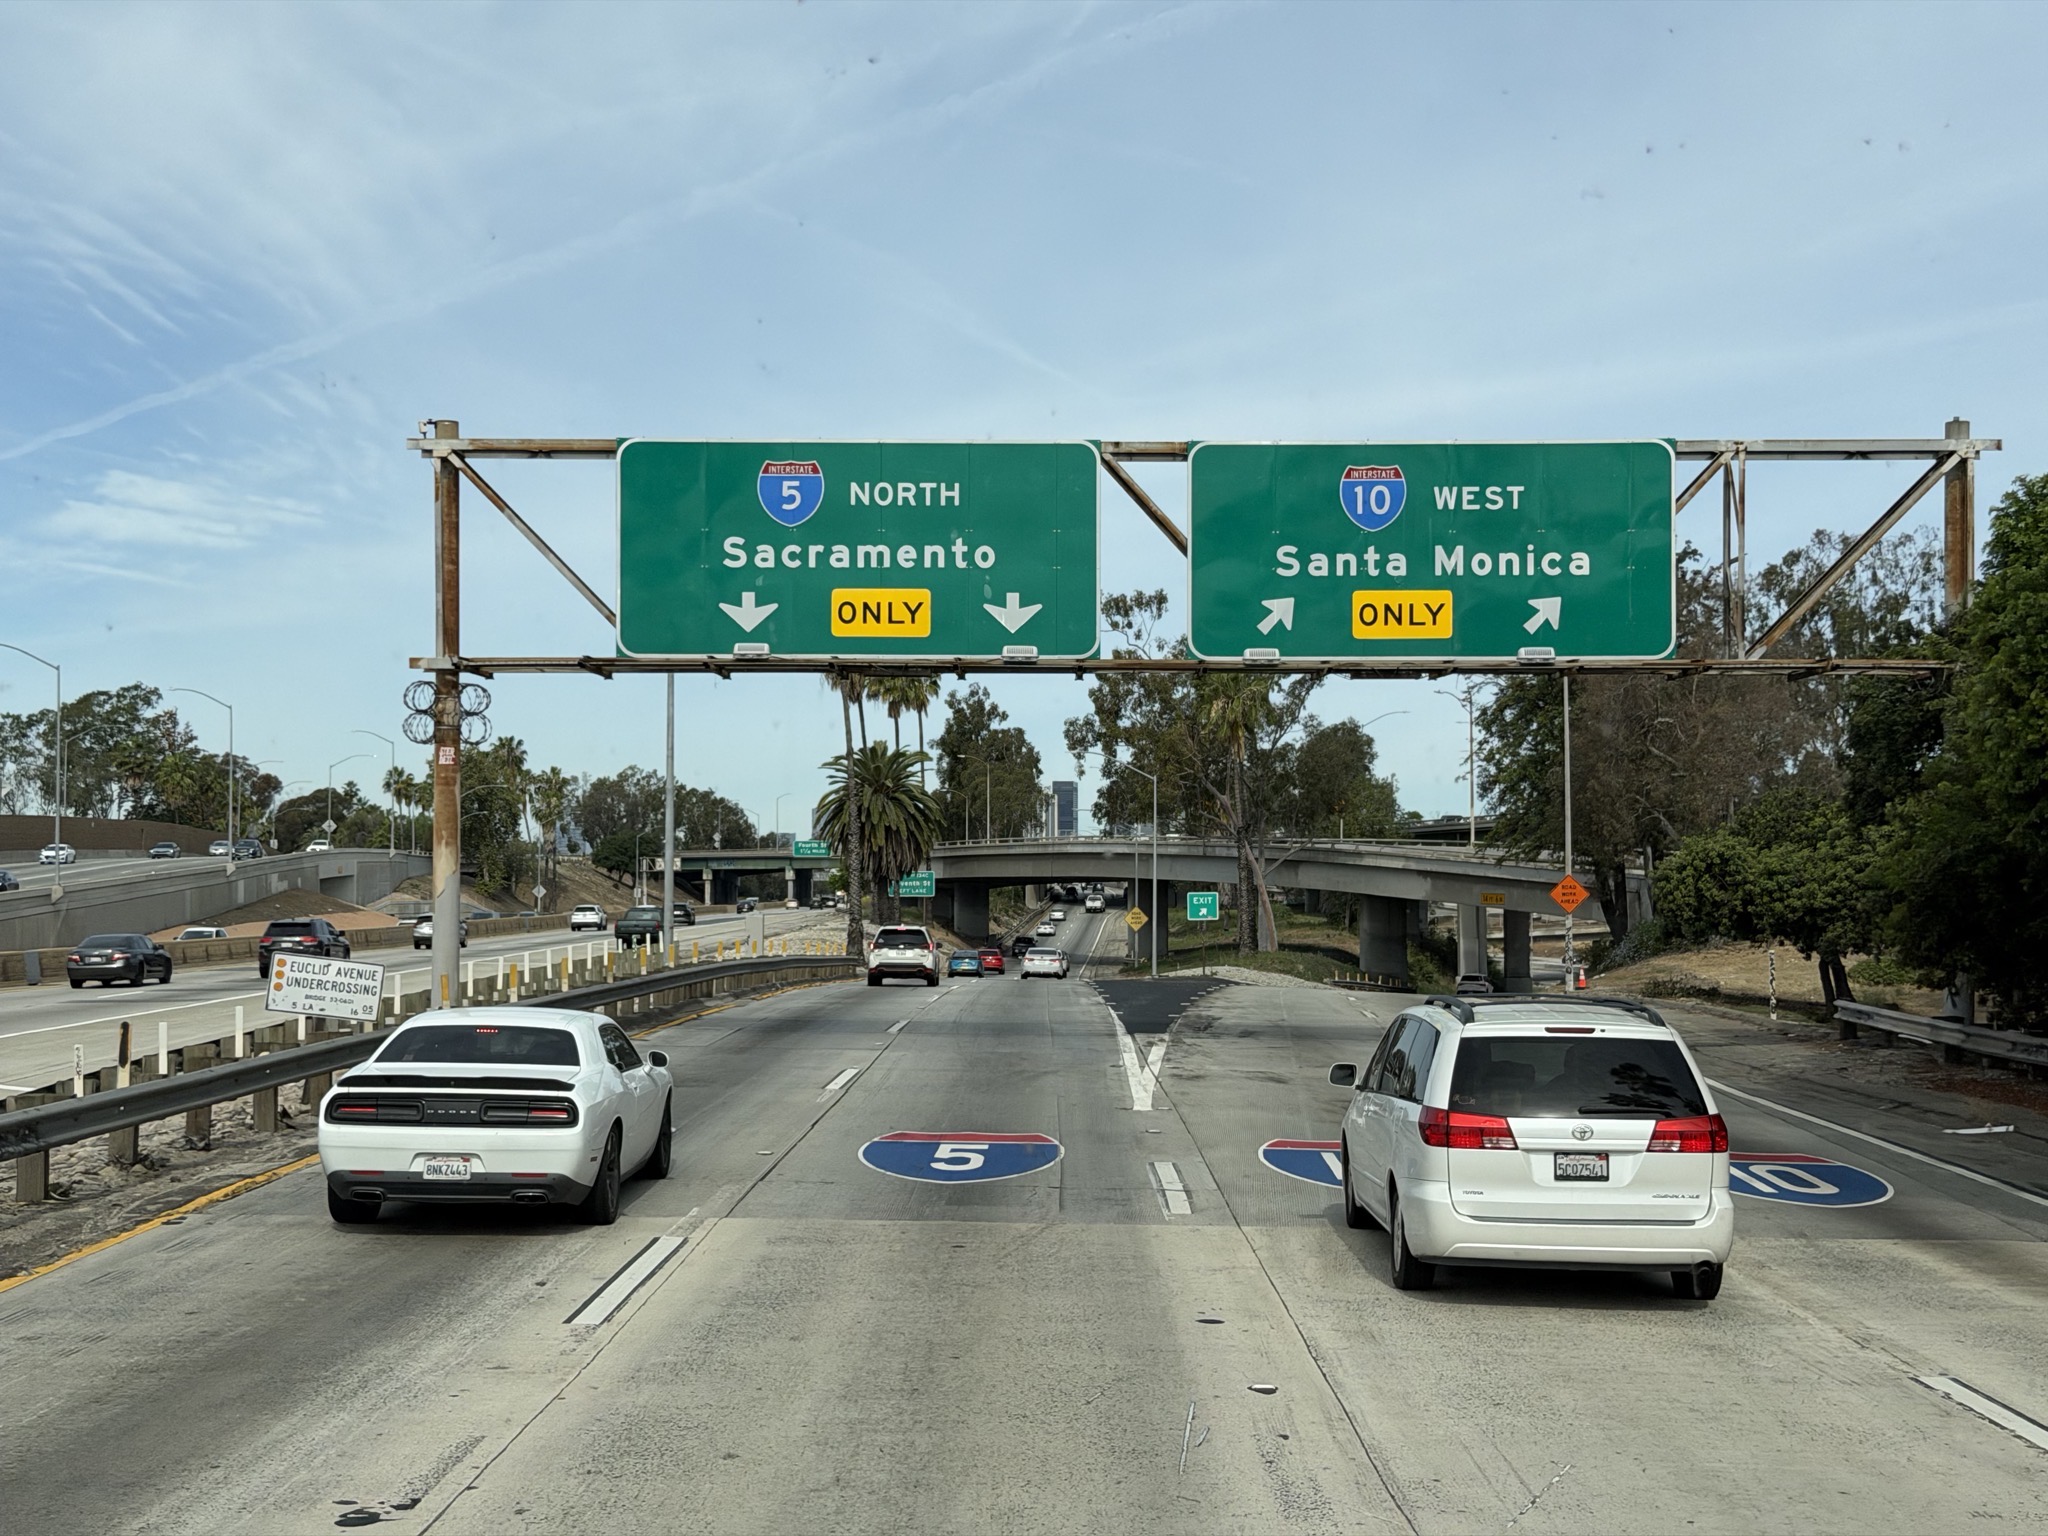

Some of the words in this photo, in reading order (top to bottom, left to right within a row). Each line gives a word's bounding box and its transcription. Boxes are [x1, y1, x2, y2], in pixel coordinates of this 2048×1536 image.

[768, 464, 814, 474] INTERSTATE
[1349, 469, 1396, 479] INTERSTATE
[781, 481, 802, 510] 5
[849, 482, 960, 506] NORTH
[1353, 485, 1391, 515] 10
[1434, 486, 1525, 510] WEST
[722, 536, 996, 569] Sacramento
[1275, 545, 1407, 577] Santa
[1434, 543, 1590, 577] Monica
[837, 601, 924, 625] ONLY
[1359, 603, 1446, 627] ONLY
[1193, 896, 1213, 905] EXIT
[290, 961, 329, 976] EUCLID
[335, 966, 379, 981] AVENUE
[286, 975, 378, 996] UNDERCROSSING
[291, 1001, 297, 1009] 5
[302, 1003, 314, 1011] LA
[350, 1008, 358, 1016] 16
[361, 1005, 373, 1013] 05
[304, 994, 326, 1002] BRIDGE
[930, 1143, 990, 1171] 5
[426, 1164, 468, 1176] 8NKZ443
[1729, 1164, 1840, 1195] 10
